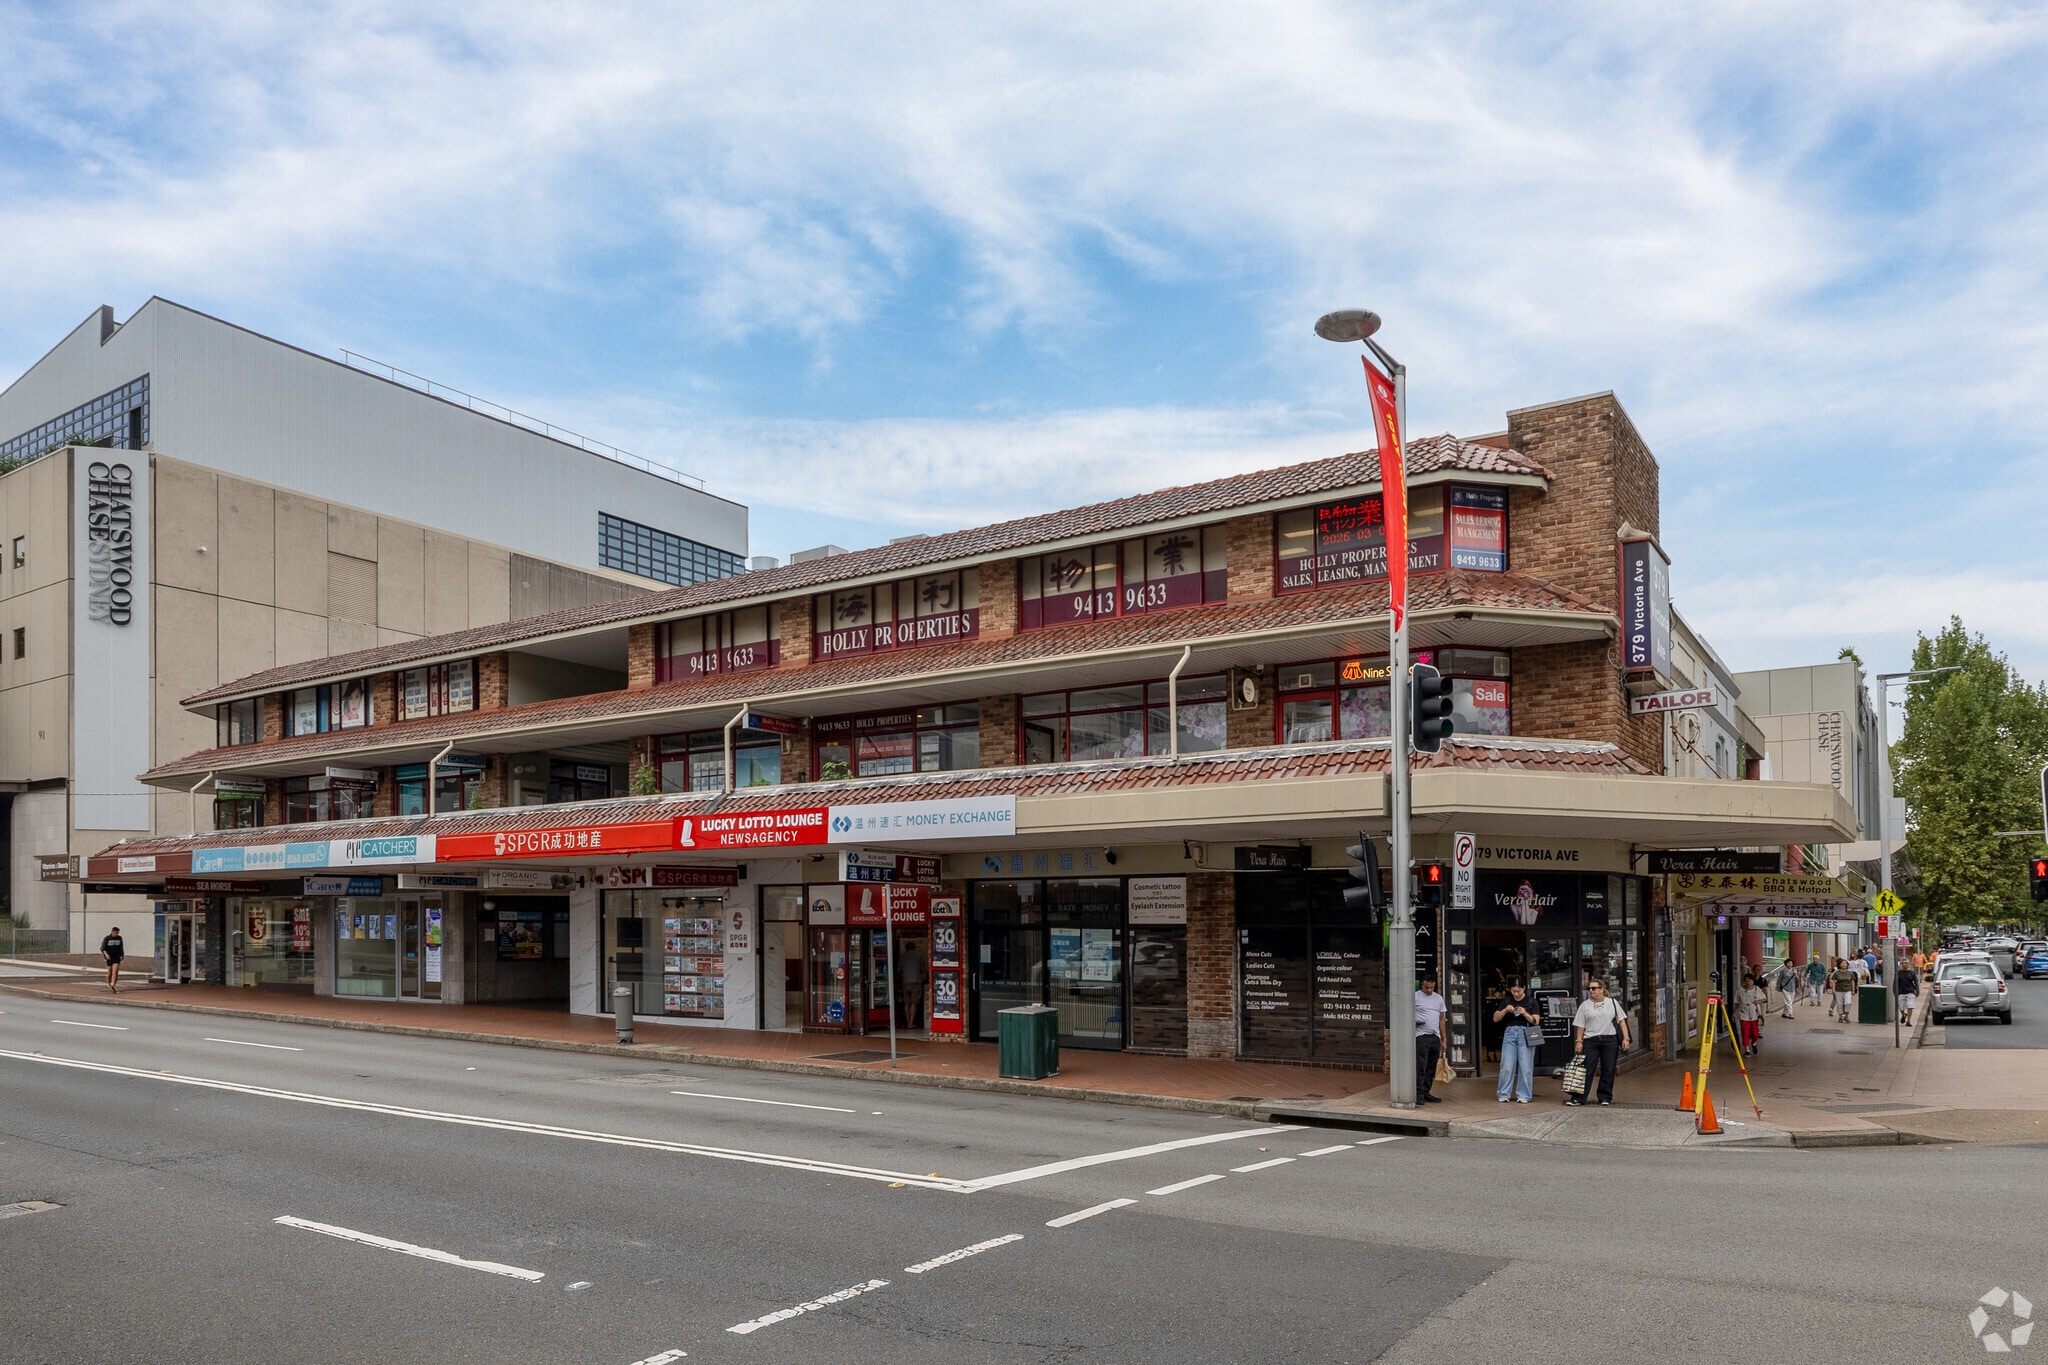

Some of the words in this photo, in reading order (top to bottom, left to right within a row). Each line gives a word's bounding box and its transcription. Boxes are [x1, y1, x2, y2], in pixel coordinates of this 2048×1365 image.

[88, 461, 112, 541] CHASE
[1475, 516, 1501, 528] LEASING
[1457, 527, 1501, 541] MANAGEMENT
[110, 463, 133, 626] CHATSWOOD
[1300, 554, 1343, 572] HOLLY
[1456, 554, 1477, 566] 9413
[1478, 557, 1500, 568] 9633
[1283, 573, 1314, 588] SALES,
[1318, 566, 1361, 583] LEASING,
[1634, 559, 1644, 583] Ave
[88, 541, 112, 626] SYDNEY
[1652, 565, 1665, 598] 379
[1074, 592, 1114, 618] 9413
[1126, 583, 1167, 610] 9633
[1634, 584, 1645, 631] Victoria
[823, 629, 868, 654] HOLLY
[1632, 634, 1646, 663] 379
[690, 652, 718, 674] 9413
[1363, 667, 1385, 680] Nine
[1476, 687, 1505, 702] Sale
[1635, 691, 1712, 711] TAILOR
[817, 722, 833, 732] 9413
[834, 720, 850, 730] 9633
[856, 718, 875, 728] HOLLY
[876, 714, 912, 726] PROPERTIES
[1818, 713, 1830, 753] CHASE
[1830, 712, 1843, 790] CHATSWOOD
[701, 817, 736, 832] LUCKY
[738, 815, 774, 829] LOTTO
[776, 813, 823, 828] LOUNGE
[906, 813, 946, 827] MONEY
[949, 810, 1011, 824] EXCHANGE
[508, 833, 550, 852] SPGR
[720, 830, 798, 845] NEWSAGENCY
[362, 840, 416, 856] CATCHERS
[1495, 848, 1553, 861] VICTORIA
[1556, 850, 1579, 862] AVE
[196, 857, 217, 871] iCare
[917, 859, 936, 867] LUCKY
[1249, 852, 1267, 866] Vera
[1269, 852, 1287, 866] Hair
[1660, 858, 1696, 870] Vera
[1700, 858, 1739, 870] Hair
[433, 878, 477, 886] CATCHERS
[501, 871, 538, 880] ORGANIC
[667, 872, 700, 883] SPGR
[917, 876, 939, 884] LOUNGE
[1457, 871, 1470, 882] NO
[1763, 877, 1832, 886] Chatswood
[196, 881, 210, 891] SEA
[211, 882, 233, 892] HORSE
[306, 880, 335, 891] iCare
[1133, 883, 1162, 891] Cosmetic
[1455, 885, 1472, 893] RIGHT
[1763, 885, 1785, 893] BBQ
[1798, 886, 1832, 894] Hotpot
[1131, 902, 1154, 911] Eyelash
[1455, 895, 1472, 904] TURN
[1494, 893, 1524, 906] Vera
[1528, 893, 1558, 906] Hair
[1057, 904, 1077, 912] RATE
[1082, 904, 1109, 912] MONEY
[294, 925, 311, 937] 10%
[1781, 919, 1801, 928] VIET
[1803, 920, 1838, 929] SENSES
[1334, 1002, 1351, 1010] 9410
[1355, 1003, 1371, 1011] 2882
